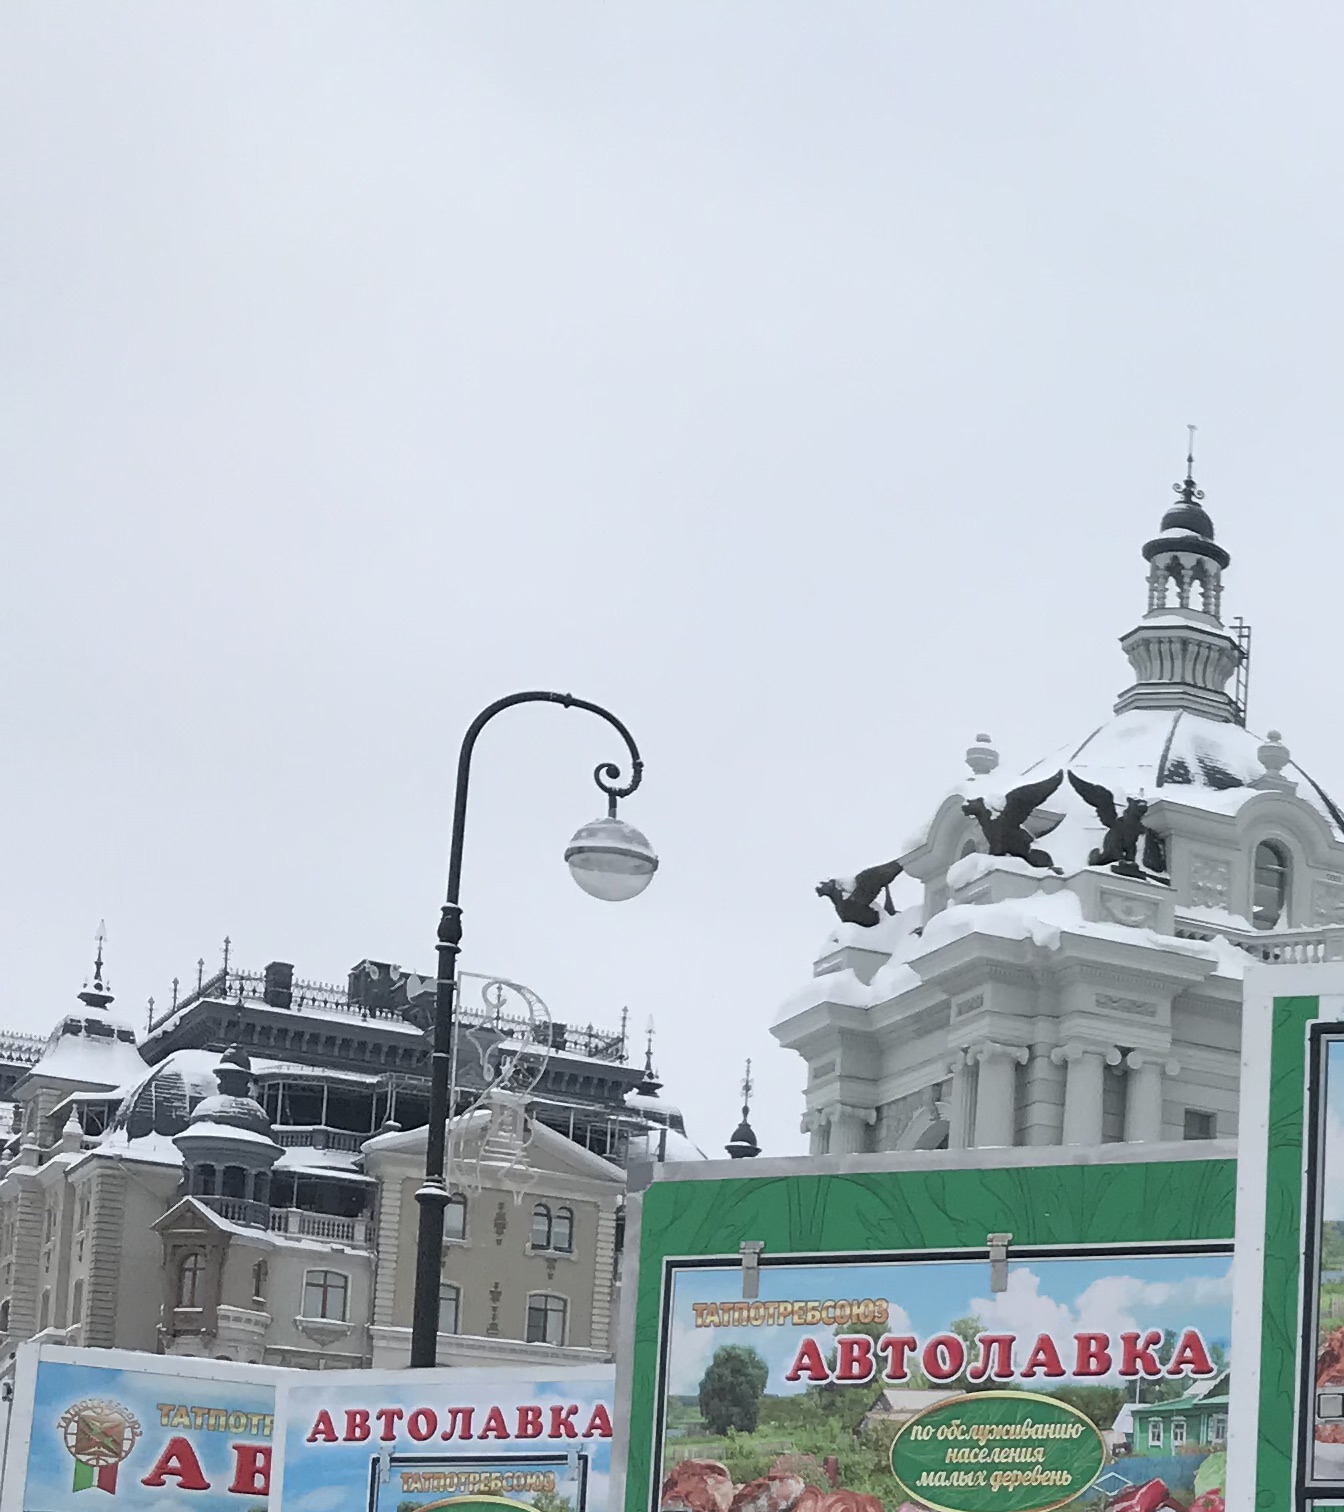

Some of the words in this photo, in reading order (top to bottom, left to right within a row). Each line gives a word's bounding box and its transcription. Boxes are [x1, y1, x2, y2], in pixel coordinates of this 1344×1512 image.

[692, 1298, 889, 1328] ТАТПОТРЕБСОЮЗ
[785, 1329, 1214, 1381] АВТОЛАВКА
[306, 1403, 613, 1442] АВТОЛАВКА
[910, 1423, 935, 1440] по
[937, 1418, 1085, 1445] обслуживанию
[945, 1446, 1045, 1463] населения
[400, 1471, 555, 1493] ТАТПОТРЕБСОЮЗ
[916, 1470, 986, 1486] малых
[990, 1465, 1072, 1491] деревень
